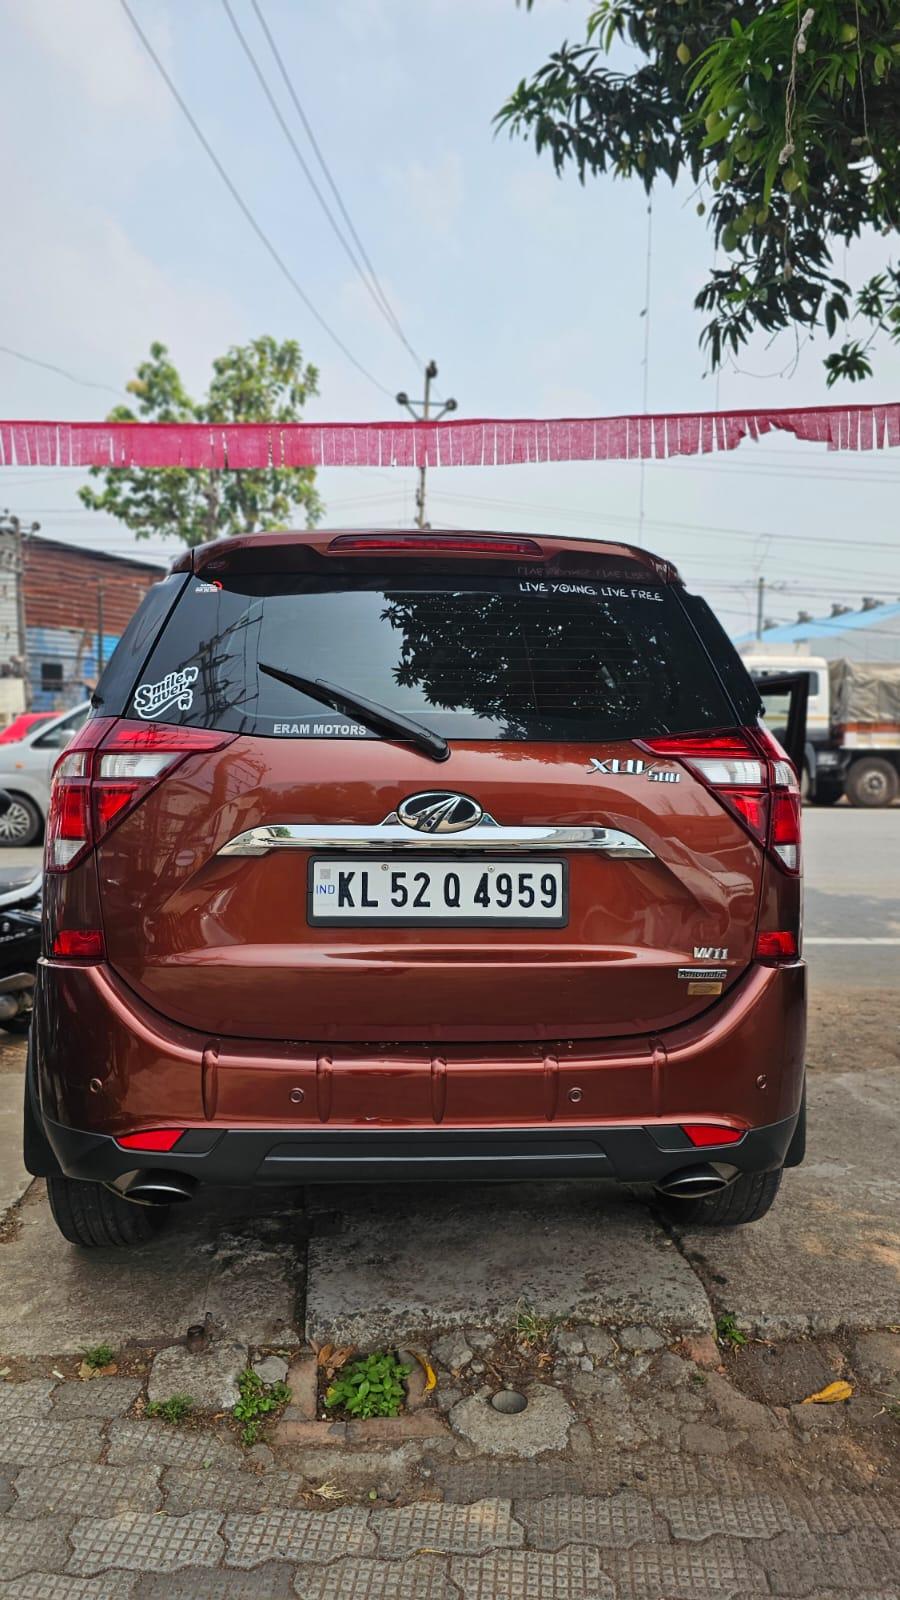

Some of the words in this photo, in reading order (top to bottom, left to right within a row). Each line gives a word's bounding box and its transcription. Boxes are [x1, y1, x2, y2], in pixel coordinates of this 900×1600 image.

[519, 582, 548, 592] LIVE
[601, 587, 629, 598] LIVE
[273, 723, 310, 734] ERAM
[313, 724, 367, 735] MOTORS
[316, 884, 335, 895] IND
[337, 871, 379, 908] KL
[390, 872, 431, 908] 52
[443, 872, 461, 908] Q
[473, 872, 557, 909] 4959
